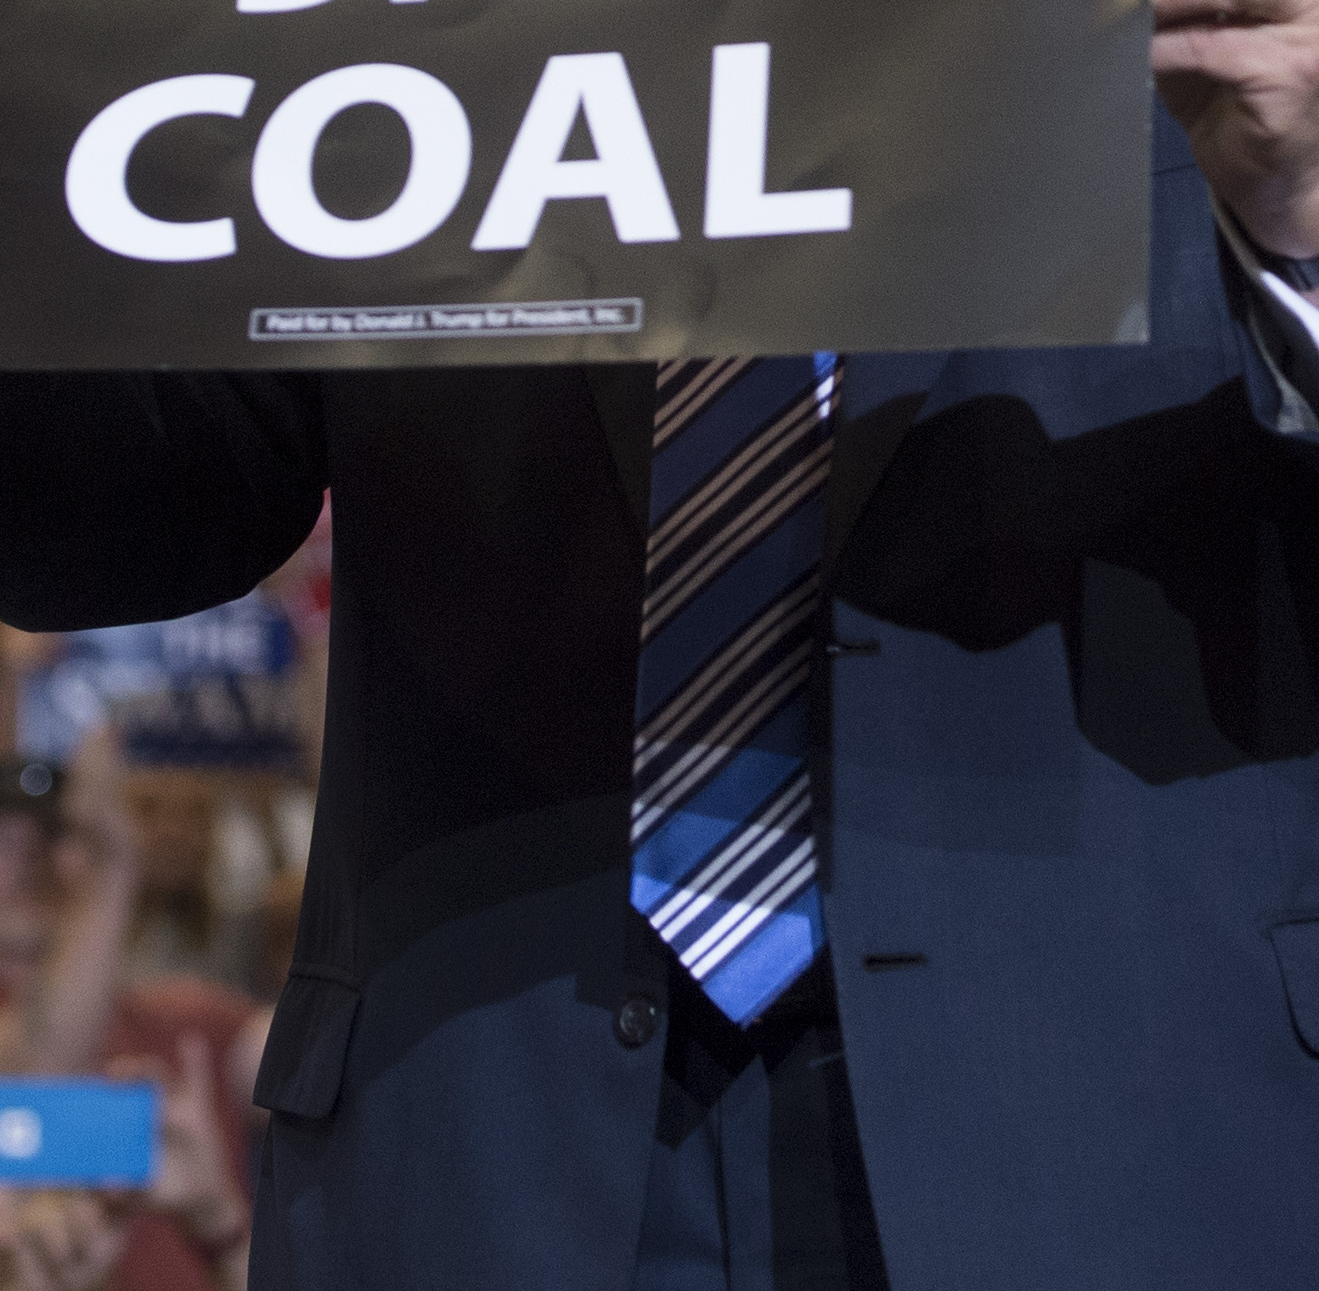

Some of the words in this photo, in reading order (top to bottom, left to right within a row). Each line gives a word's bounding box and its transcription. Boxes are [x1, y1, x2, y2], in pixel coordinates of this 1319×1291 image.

[65, 42, 852, 261] COAL
[266, 314, 303, 331] Paid
[305, 314, 328, 331] for
[331, 315, 352, 332] by
[354, 313, 413, 330] Donald
[430, 311, 483, 329] Trump
[485, 311, 509, 326] for
